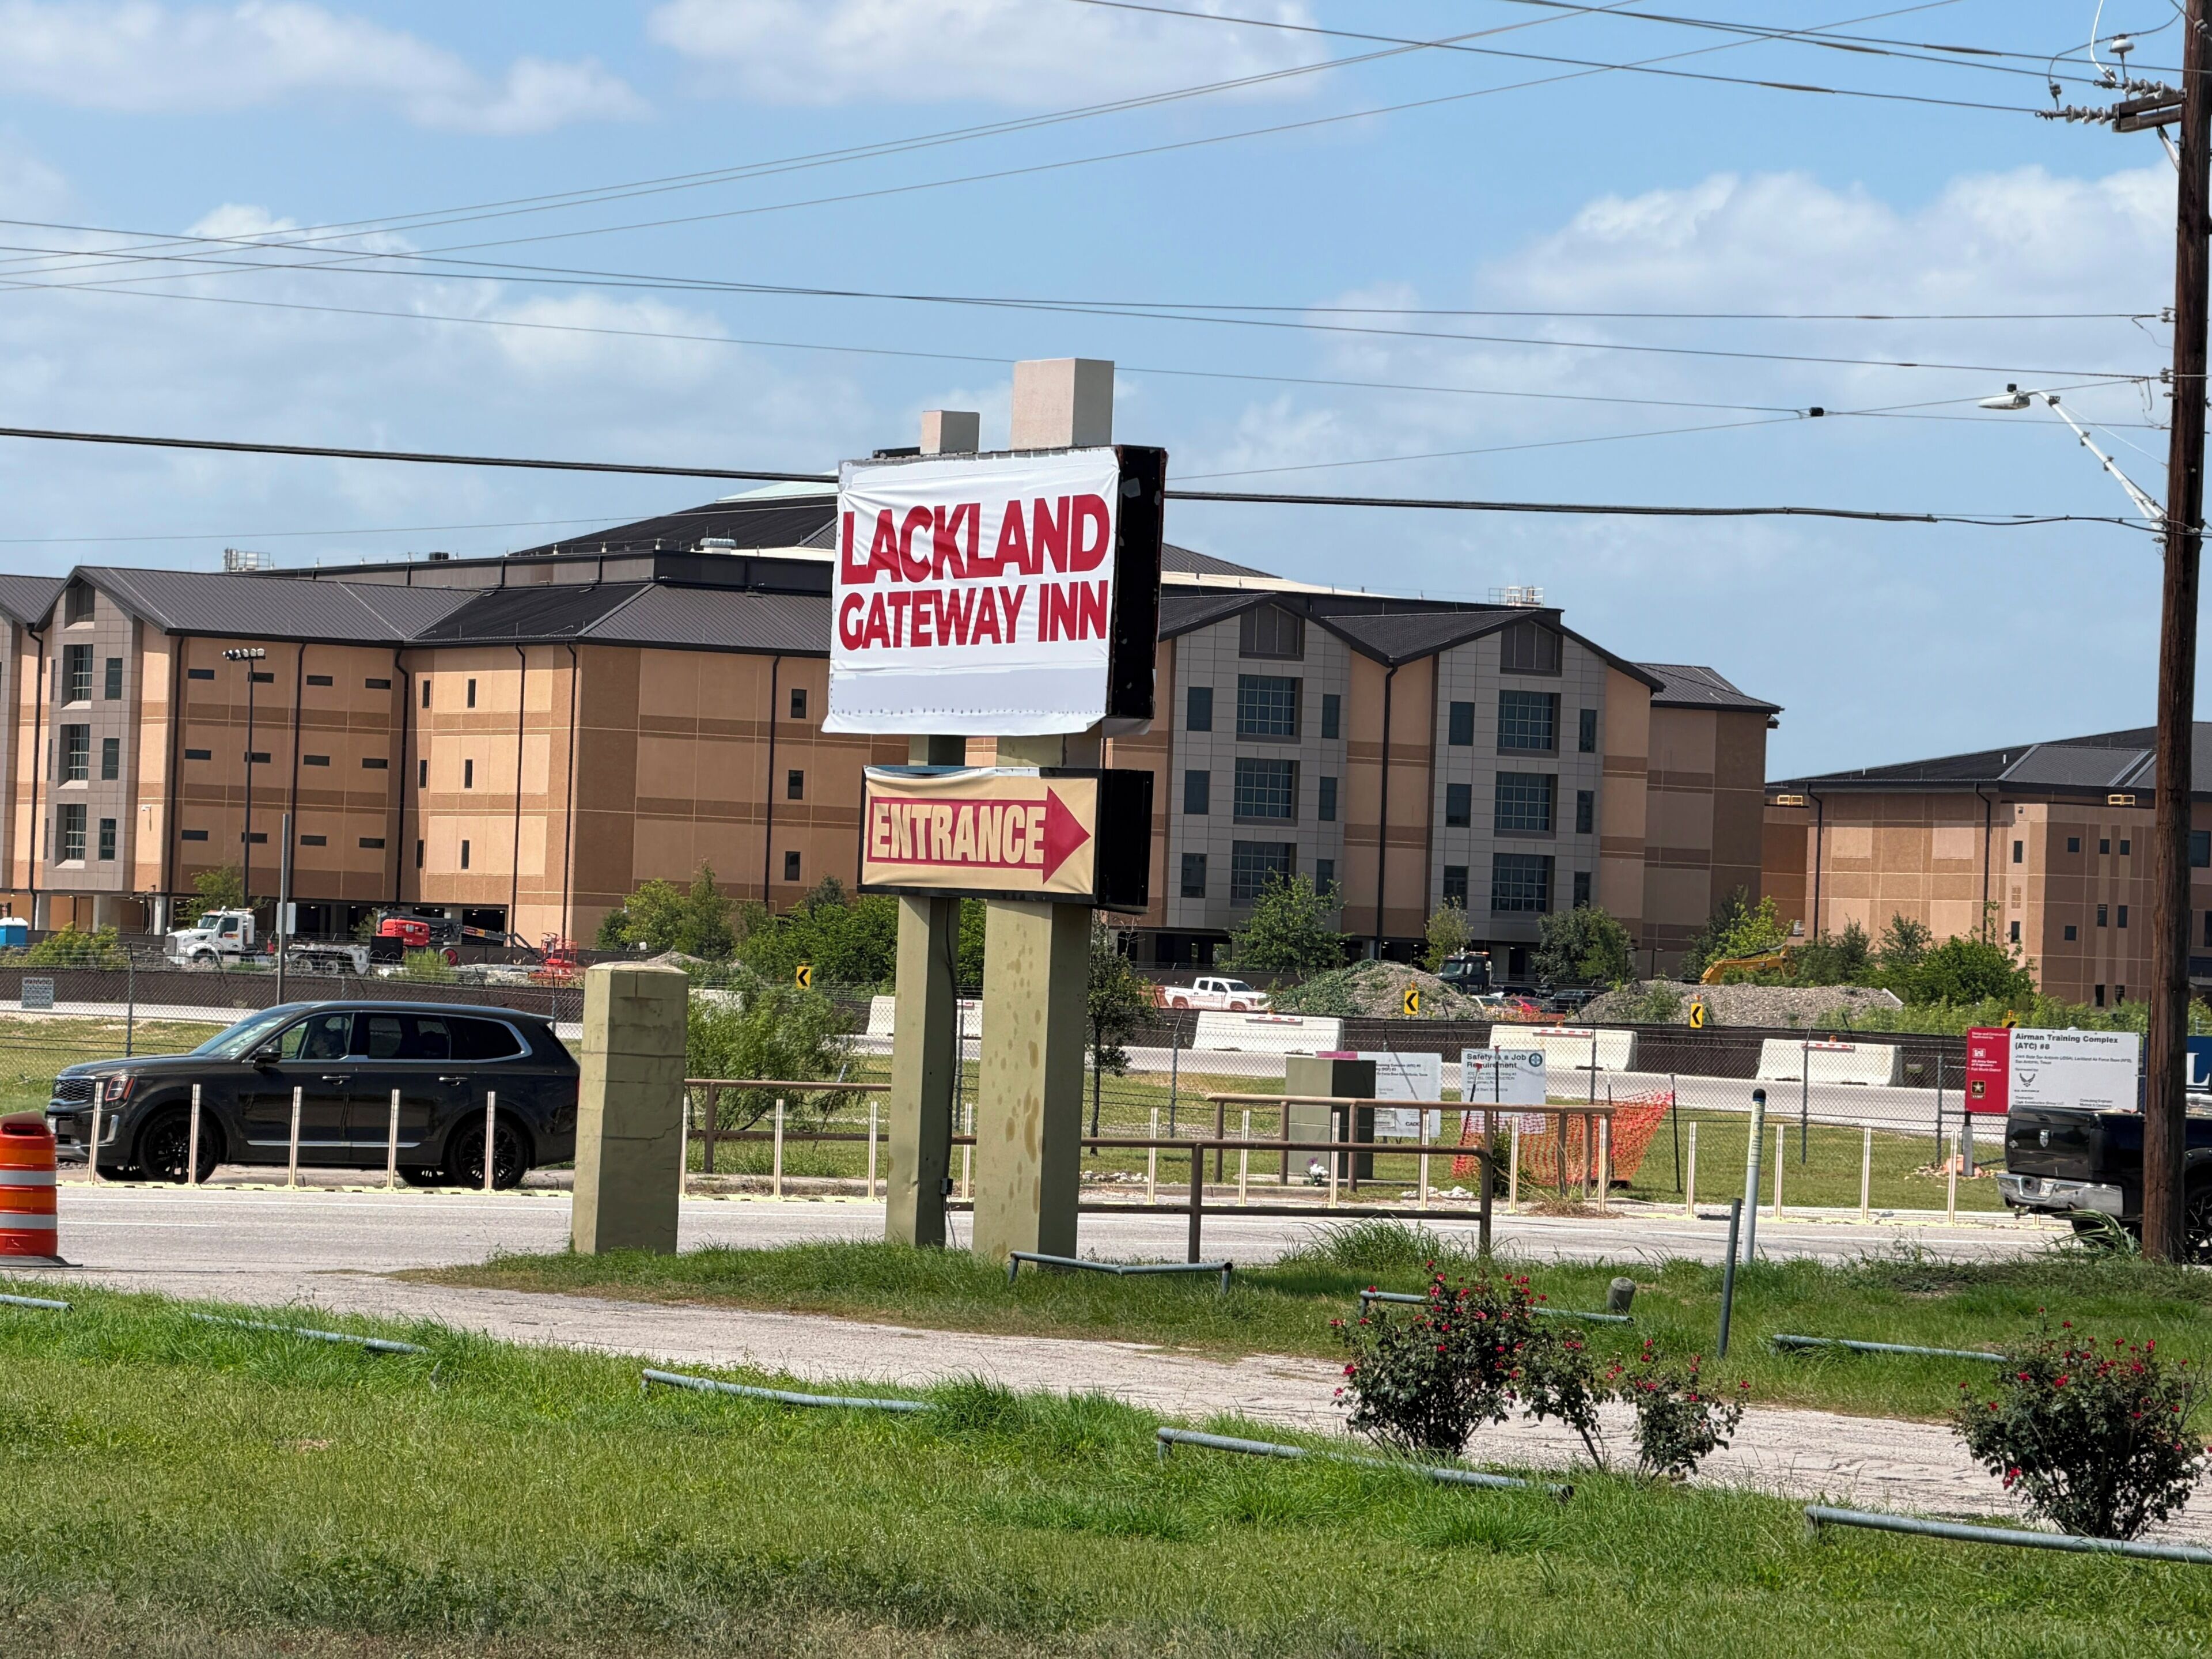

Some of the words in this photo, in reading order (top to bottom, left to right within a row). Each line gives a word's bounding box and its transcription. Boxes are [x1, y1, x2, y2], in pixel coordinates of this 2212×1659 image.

[841, 494, 1110, 585] LACKLAND
[839, 585, 1027, 651] GATEWAY
[1038, 579, 1109, 642] INN
[872, 802, 1047, 864] ENTRANCE
[1467, 1053, 1492, 1061] Safety
[2047, 1034, 2080, 1043] Training
[2083, 1036, 2119, 1044] Complex
